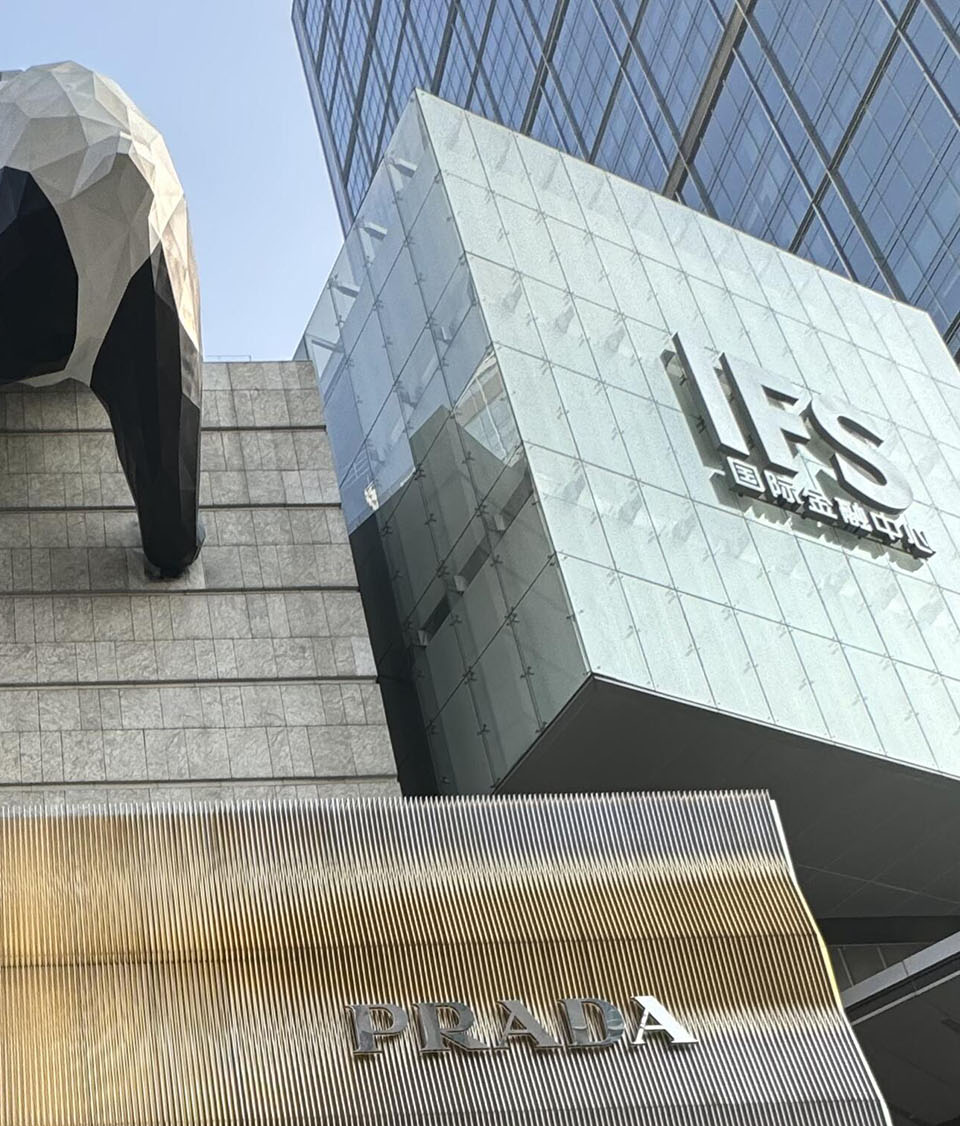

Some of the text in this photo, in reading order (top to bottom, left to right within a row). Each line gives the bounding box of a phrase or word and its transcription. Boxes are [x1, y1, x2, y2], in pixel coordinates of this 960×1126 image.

[669, 331, 914, 515] IFS
[726, 456, 936, 559] 国际金融中心
[344, 995, 699, 1055] PRADA
